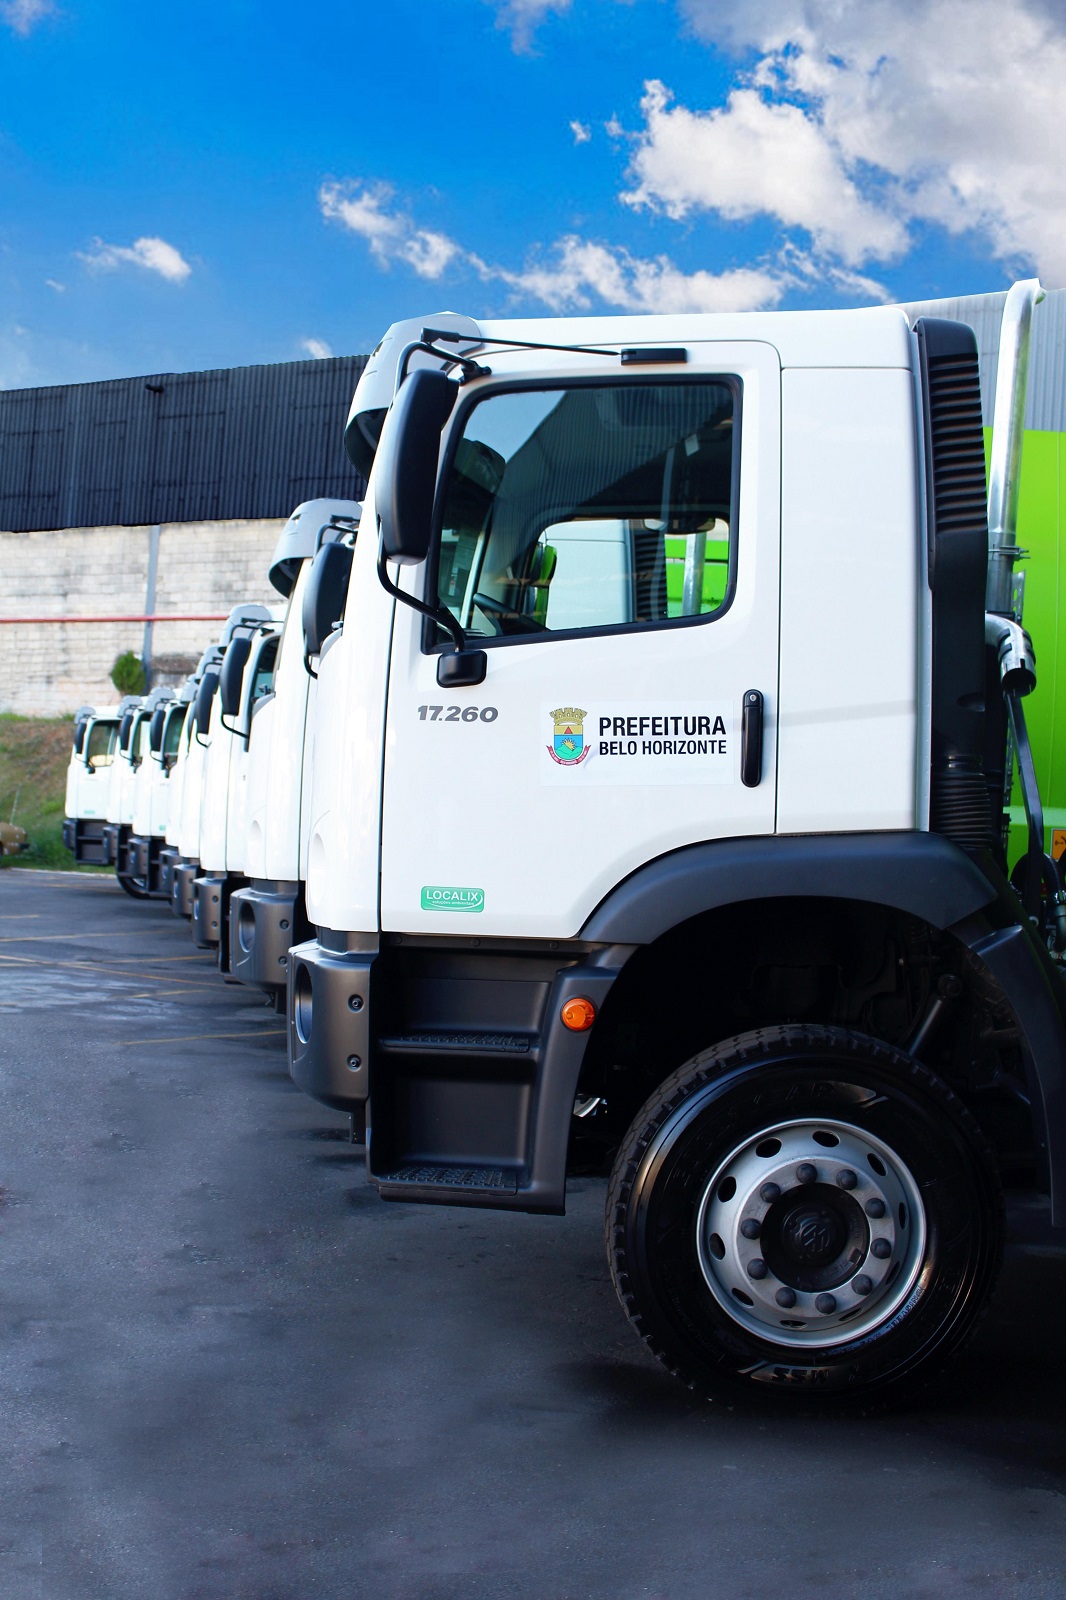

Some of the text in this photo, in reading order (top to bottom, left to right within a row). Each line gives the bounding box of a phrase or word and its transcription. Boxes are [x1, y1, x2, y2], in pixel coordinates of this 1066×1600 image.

[417, 705, 499, 723] 17.260
[599, 716, 727, 736] PREFEITURA
[599, 740, 727, 755] BELO HORIZONTE
[426, 890, 479, 901] LOCALIX
